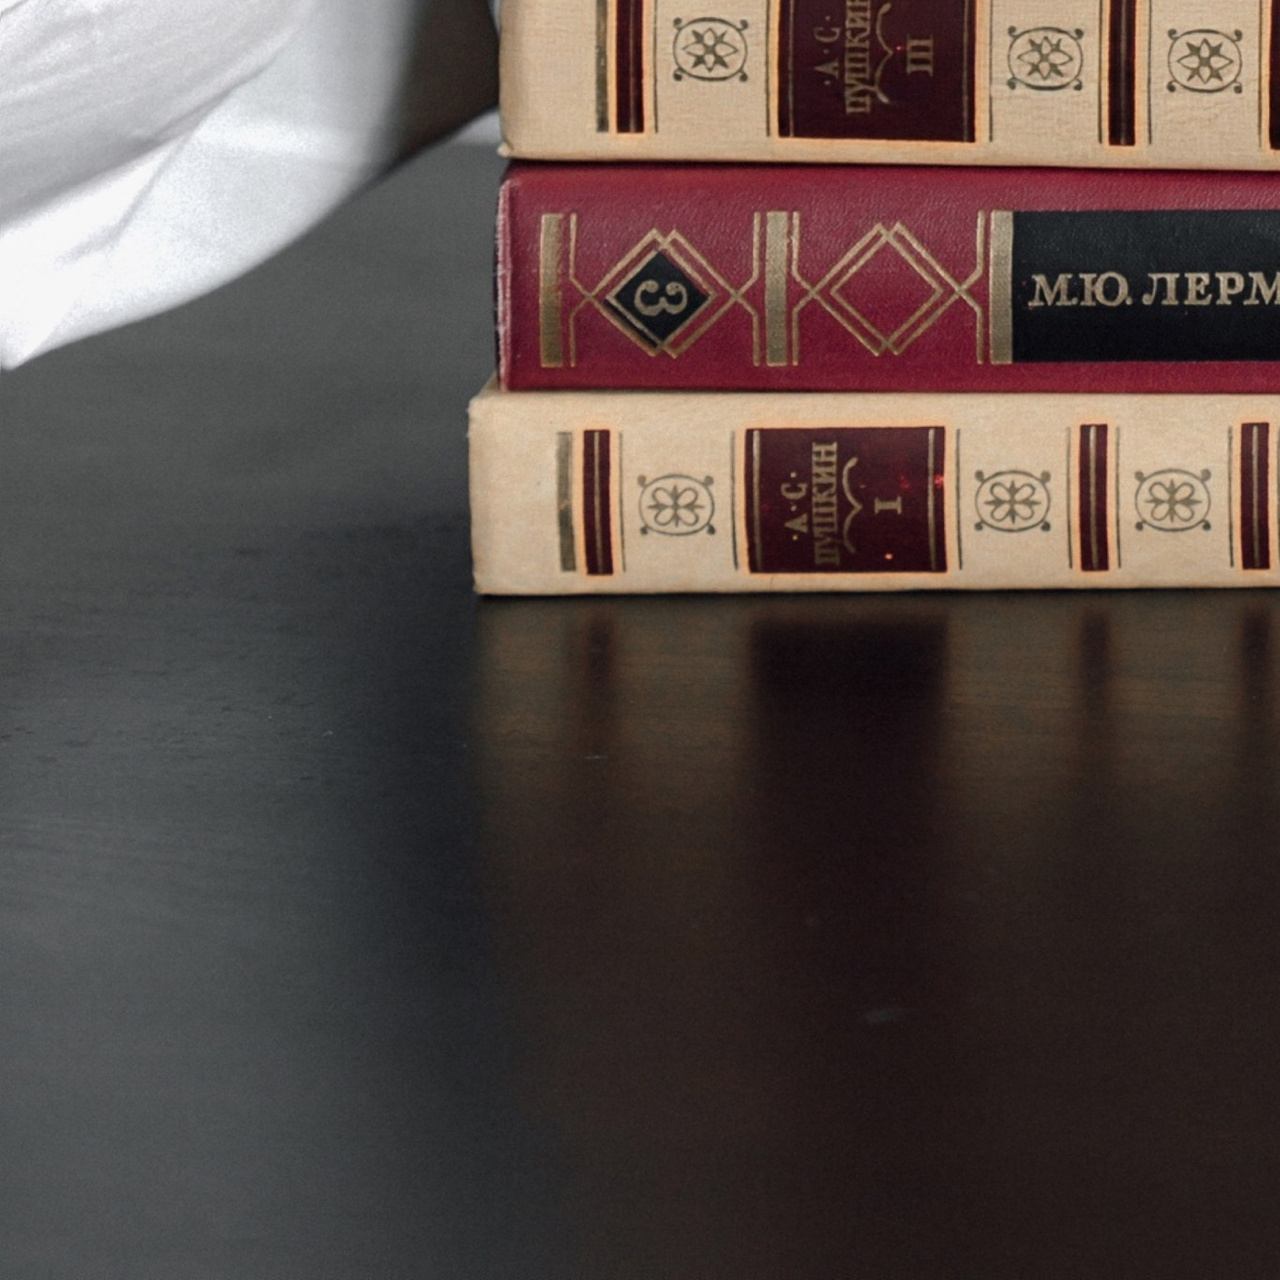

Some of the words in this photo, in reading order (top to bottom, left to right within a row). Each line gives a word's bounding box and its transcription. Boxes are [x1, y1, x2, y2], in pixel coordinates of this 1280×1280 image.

[633, 280, 688, 317] 3
[1027, 271, 1133, 307] М.Ю.
[811, 441, 840, 566] ПУШКИН
